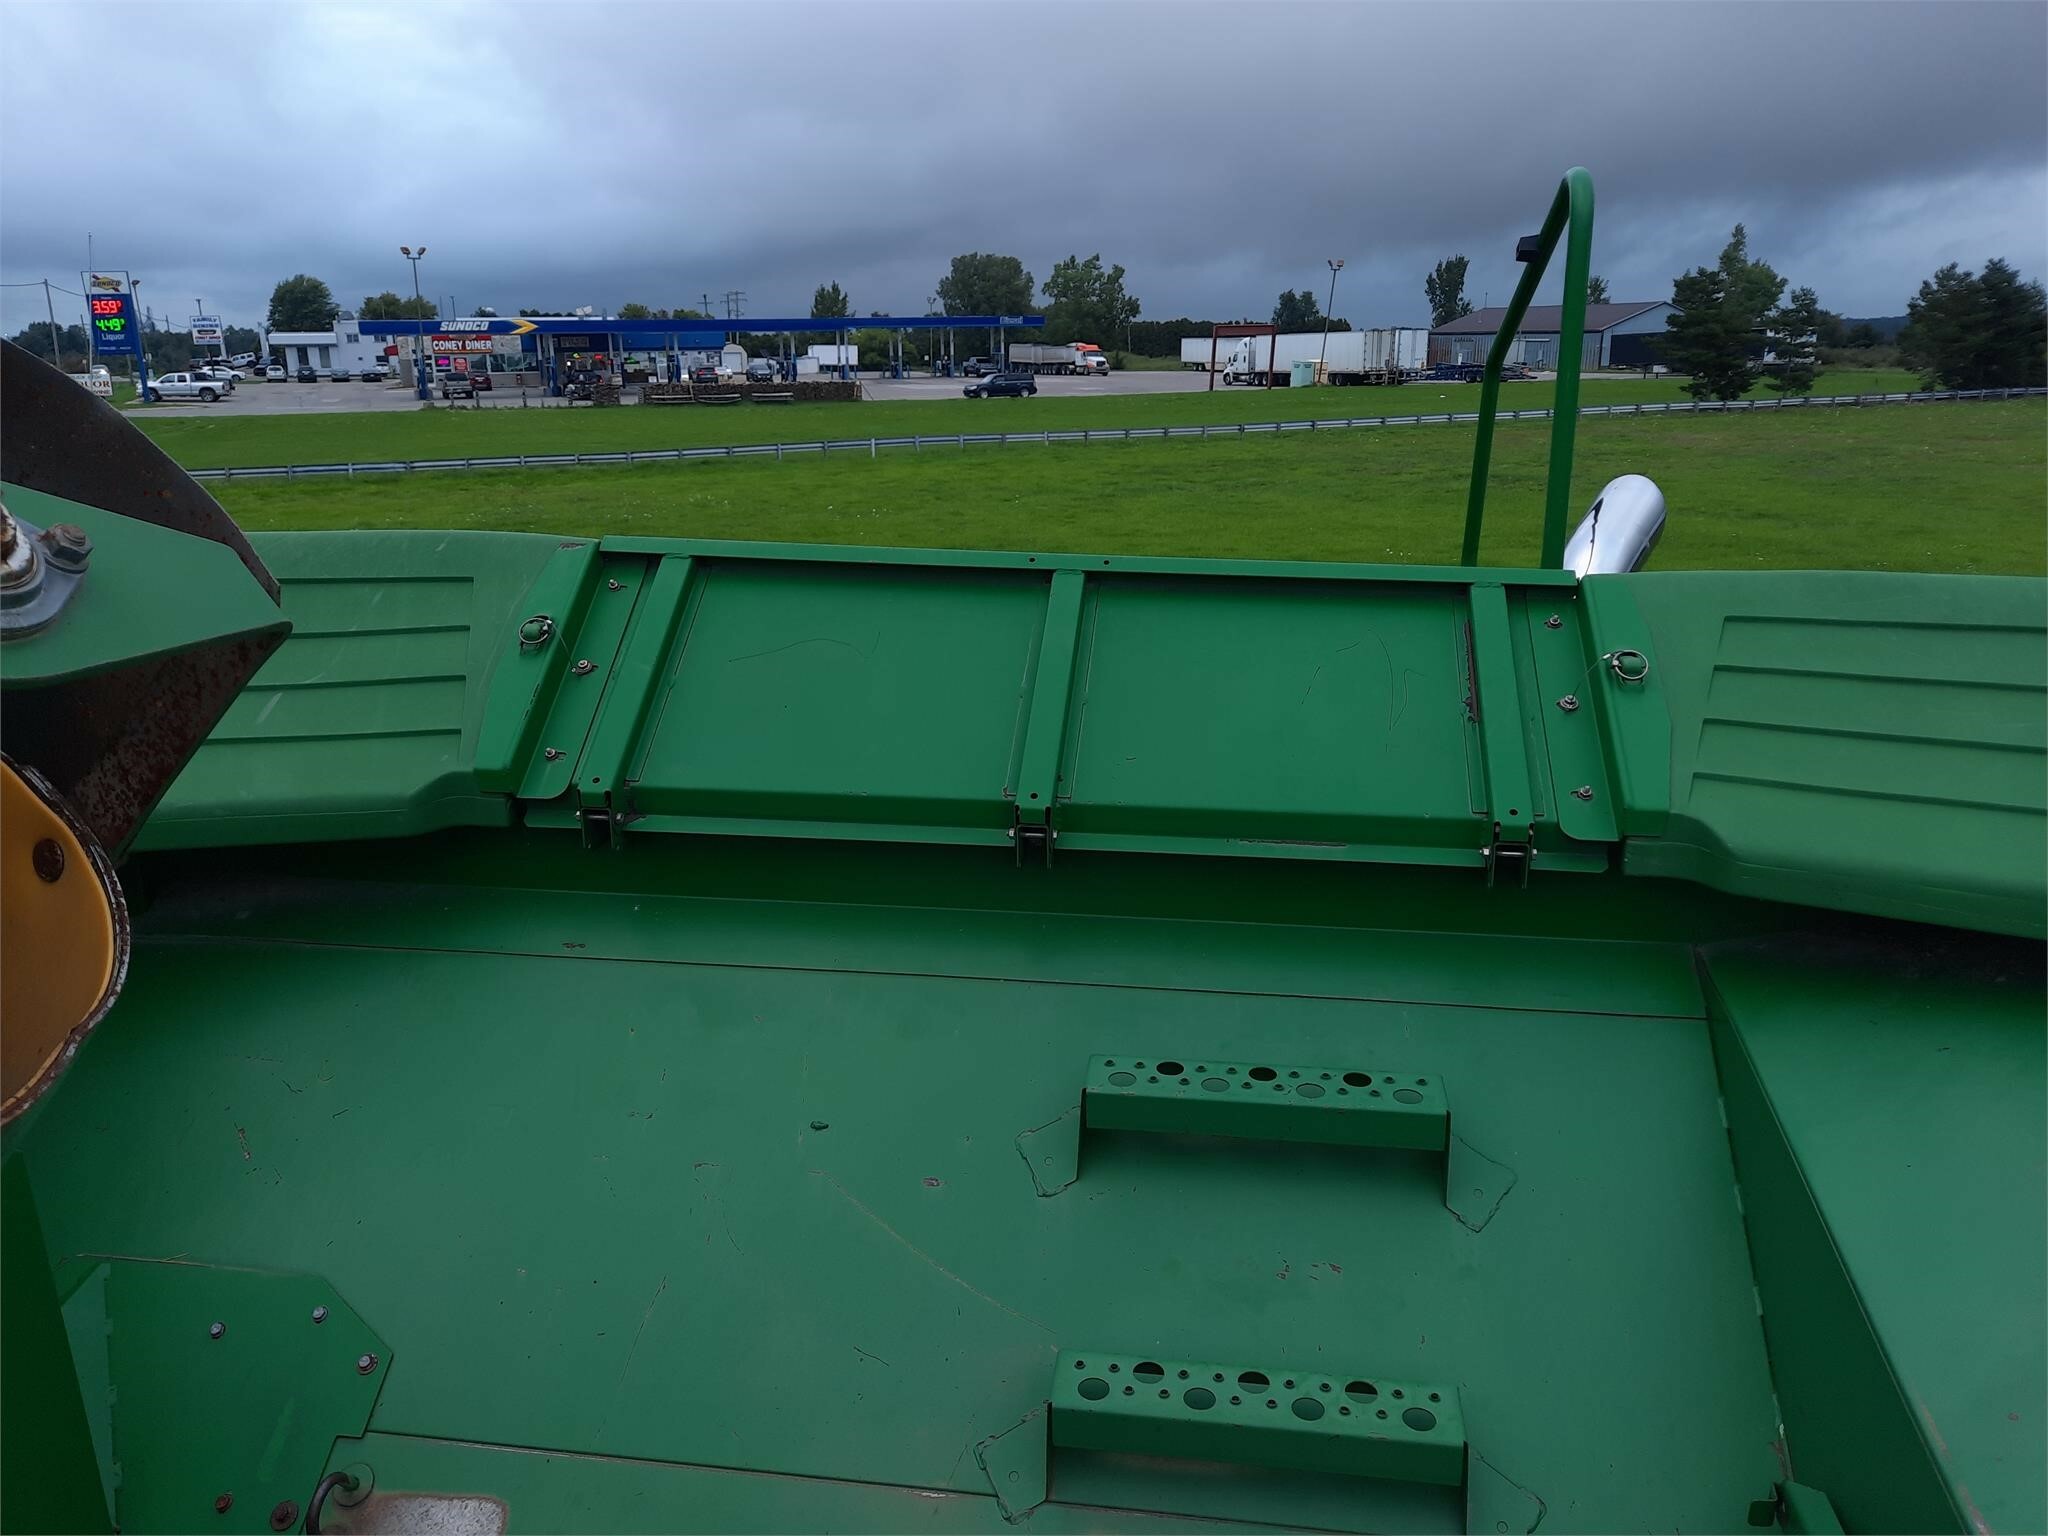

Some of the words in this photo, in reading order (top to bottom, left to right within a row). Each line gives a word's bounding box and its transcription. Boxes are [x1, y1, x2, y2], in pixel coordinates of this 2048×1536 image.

[439, 321, 490, 331] SUNOCO
[101, 333, 125, 342] Liquor
[432, 340, 463, 350] CONEY
[465, 340, 493, 350] DINER
